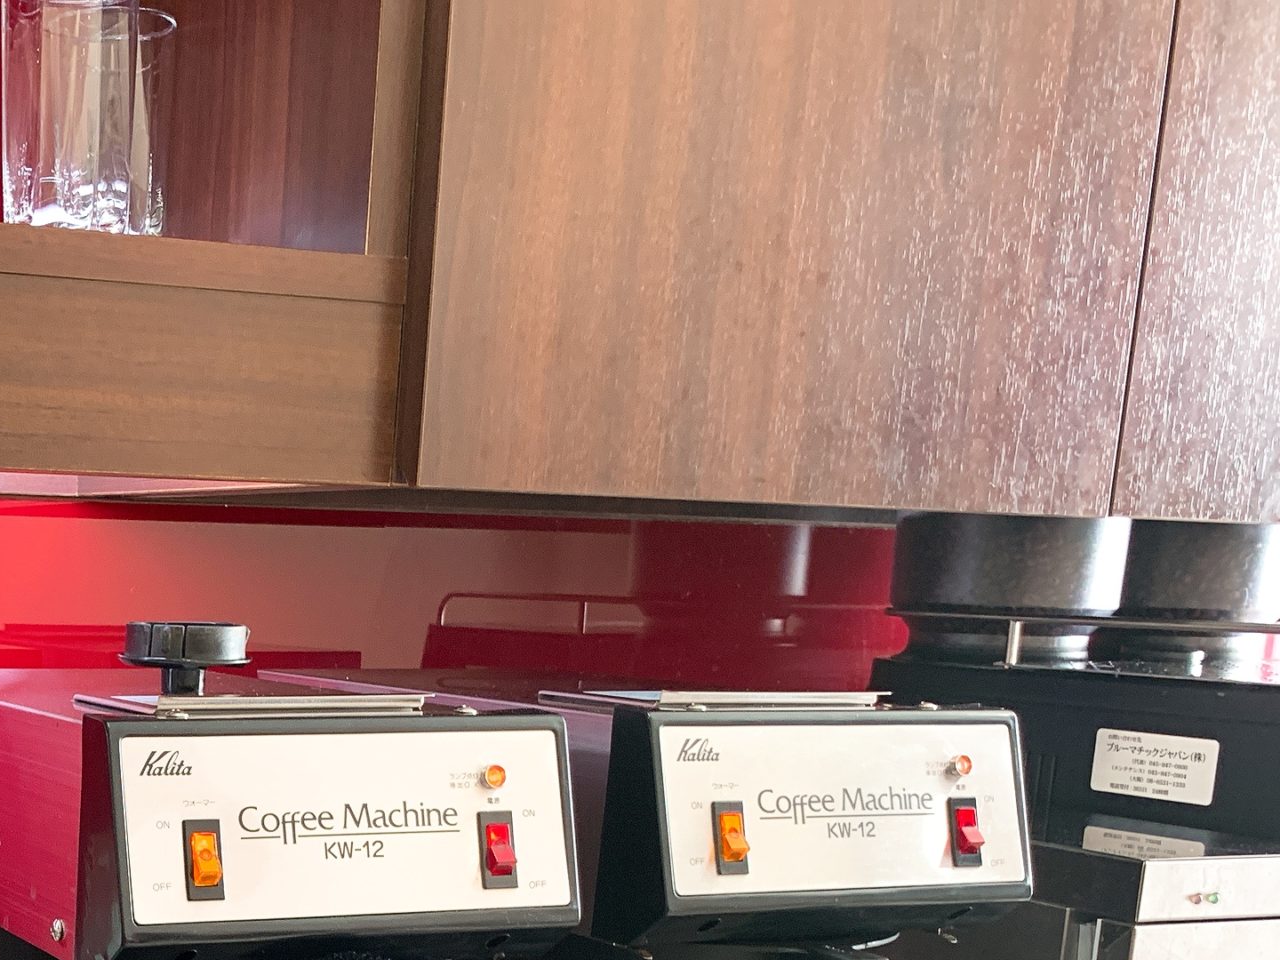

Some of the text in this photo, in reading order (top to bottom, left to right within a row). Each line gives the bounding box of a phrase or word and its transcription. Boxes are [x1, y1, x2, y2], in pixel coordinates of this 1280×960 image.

[677, 738, 720, 762] Kalita
[140, 750, 192, 777] Kalita
[691, 801, 703, 810] ON
[757, 787, 933, 824] Coffee Machine
[522, 809, 535, 817] ON
[156, 820, 170, 829] ON
[238, 801, 459, 845] Coffee Machine
[827, 822, 876, 838] KW-12
[324, 841, 384, 859] KW-12
[690, 857, 705, 866] OFF
[152, 883, 172, 892] OFF
[529, 880, 546, 889] OFF
